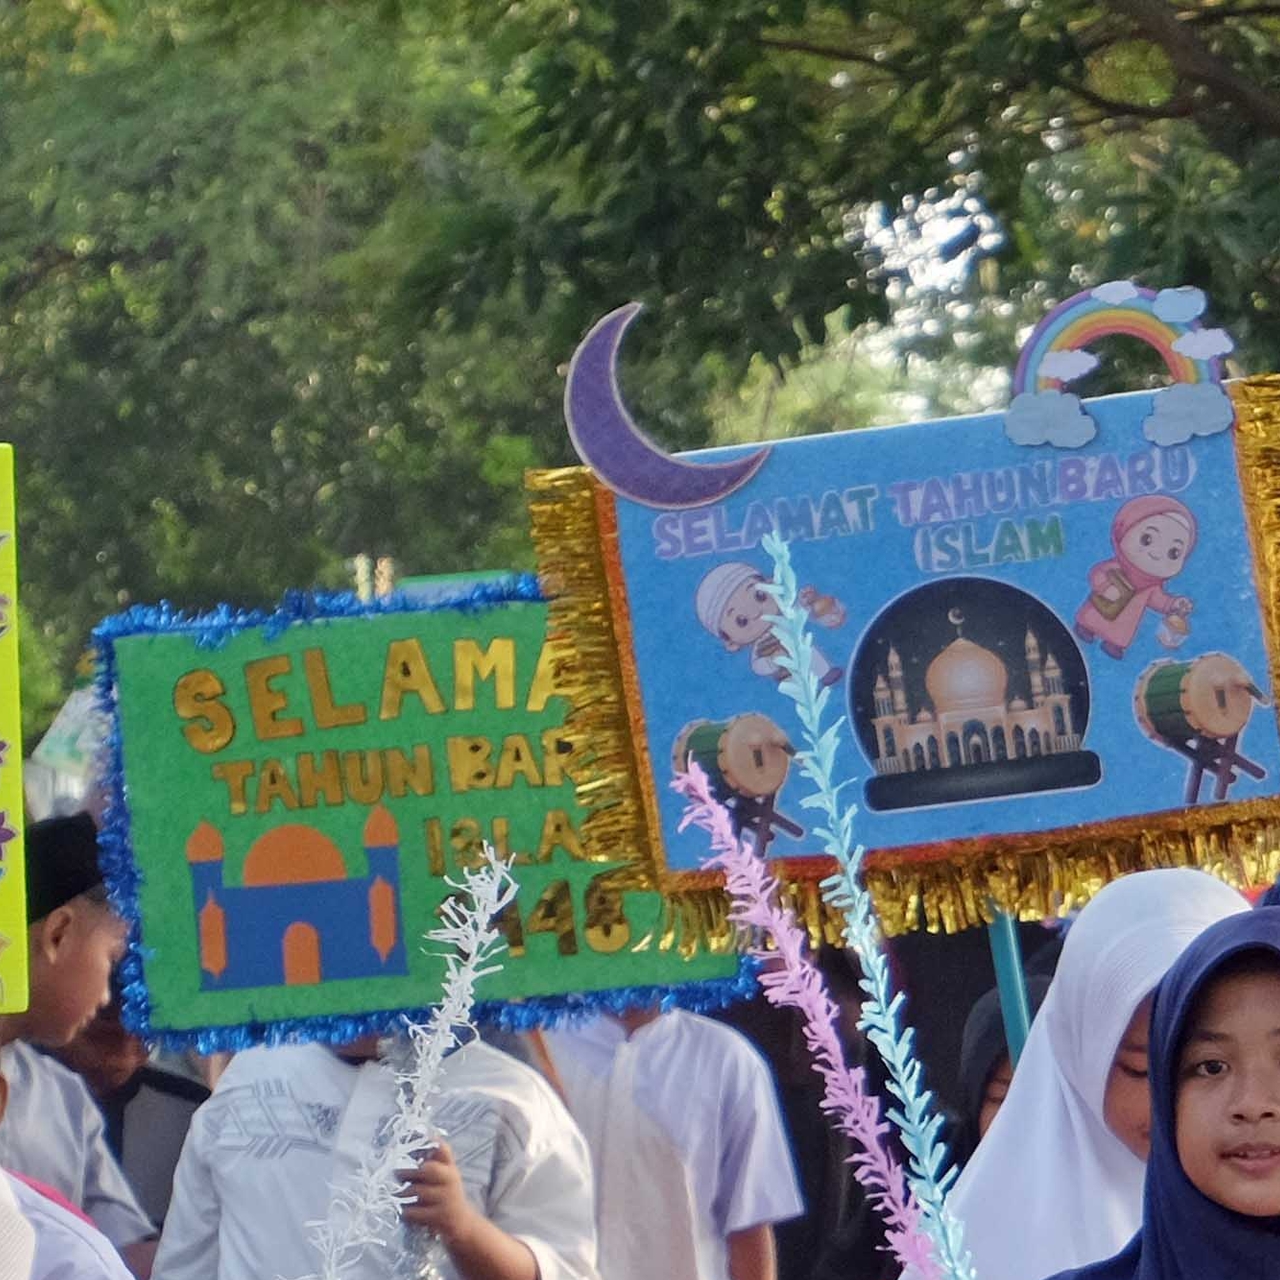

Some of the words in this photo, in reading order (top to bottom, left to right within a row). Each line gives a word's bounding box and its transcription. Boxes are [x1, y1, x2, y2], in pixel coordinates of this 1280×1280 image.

[652, 484, 878, 560] SELAMAT
[887, 459, 1051, 526] TAHUN
[1056, 446, 1198, 502] BARU
[914, 511, 1065, 573] ISLAM
[173, 635, 574, 754] SELAMA
[213, 743, 435, 815] TAHUN
[446, 727, 578, 792] BAR
[425, 809, 586, 876] ISLA
